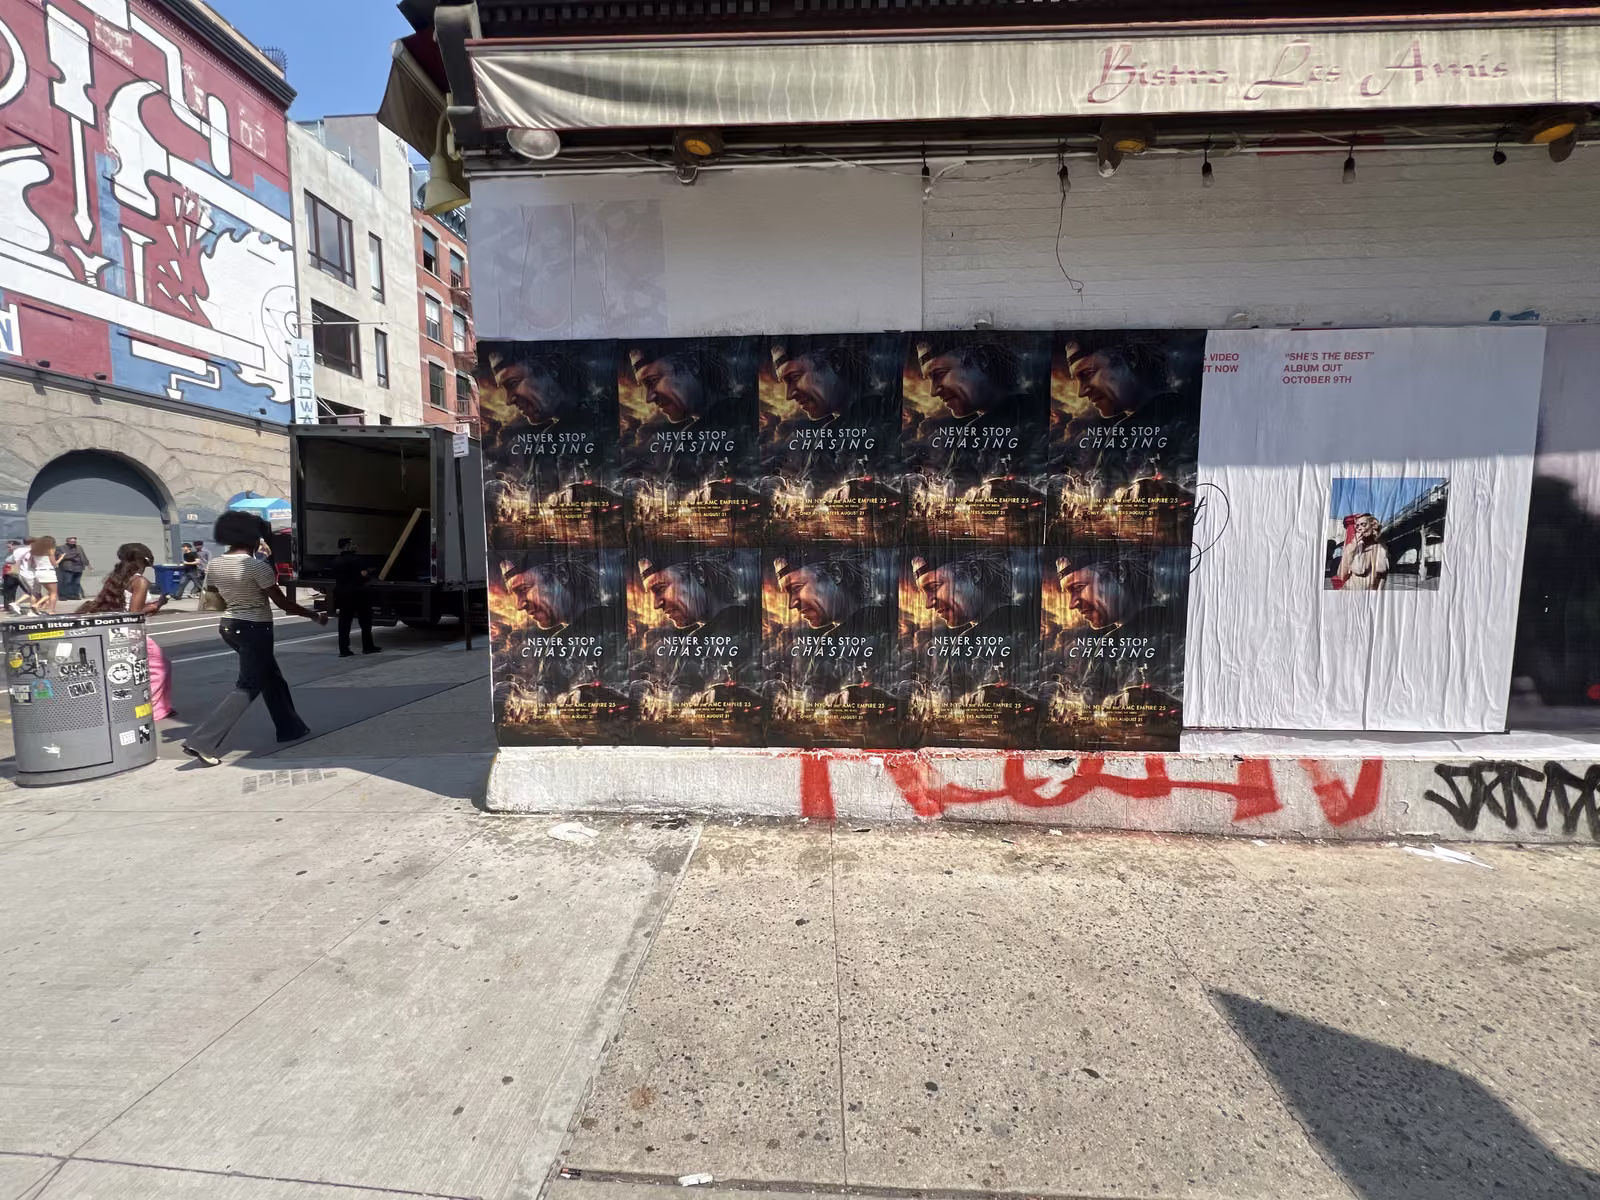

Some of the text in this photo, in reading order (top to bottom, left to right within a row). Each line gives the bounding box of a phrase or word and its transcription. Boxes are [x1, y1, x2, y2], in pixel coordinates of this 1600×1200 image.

[1087, 38, 1509, 104] Bistro Les Amis
[1210, 353, 1240, 361] VIDEO
[1322, 352, 1341, 361] THE
[1214, 364, 1239, 373] NOW
[1284, 364, 1343, 372] ALBUM OUT
[1282, 376, 1352, 384] OCTOBER 9TH
[656, 430, 727, 440] NEVER STOP
[796, 428, 867, 438] NEVER STOP
[939, 427, 1012, 437] NEVER STOP
[1087, 426, 1160, 436] NEVER STOP
[518, 432, 586, 442] NEVER STOP
[650, 441, 735, 452] CHASING
[788, 438, 875, 450] CHASING
[932, 437, 1018, 449] CHASING
[1079, 437, 1168, 448] CHASING
[511, 442, 595, 454] CHASING
[528, 636, 595, 646] NEVER STOP
[663, 636, 732, 646] NEVER STOP
[797, 636, 866, 646] NEVER STOP
[934, 636, 1004, 646] NEVER STOP
[1077, 638, 1148, 647] NEVER STOP
[521, 646, 603, 658] CHASING
[656, 646, 739, 657] CHASING
[791, 646, 874, 658] CHASING
[927, 646, 1012, 658] CHASING
[1069, 647, 1156, 658] CHASING
